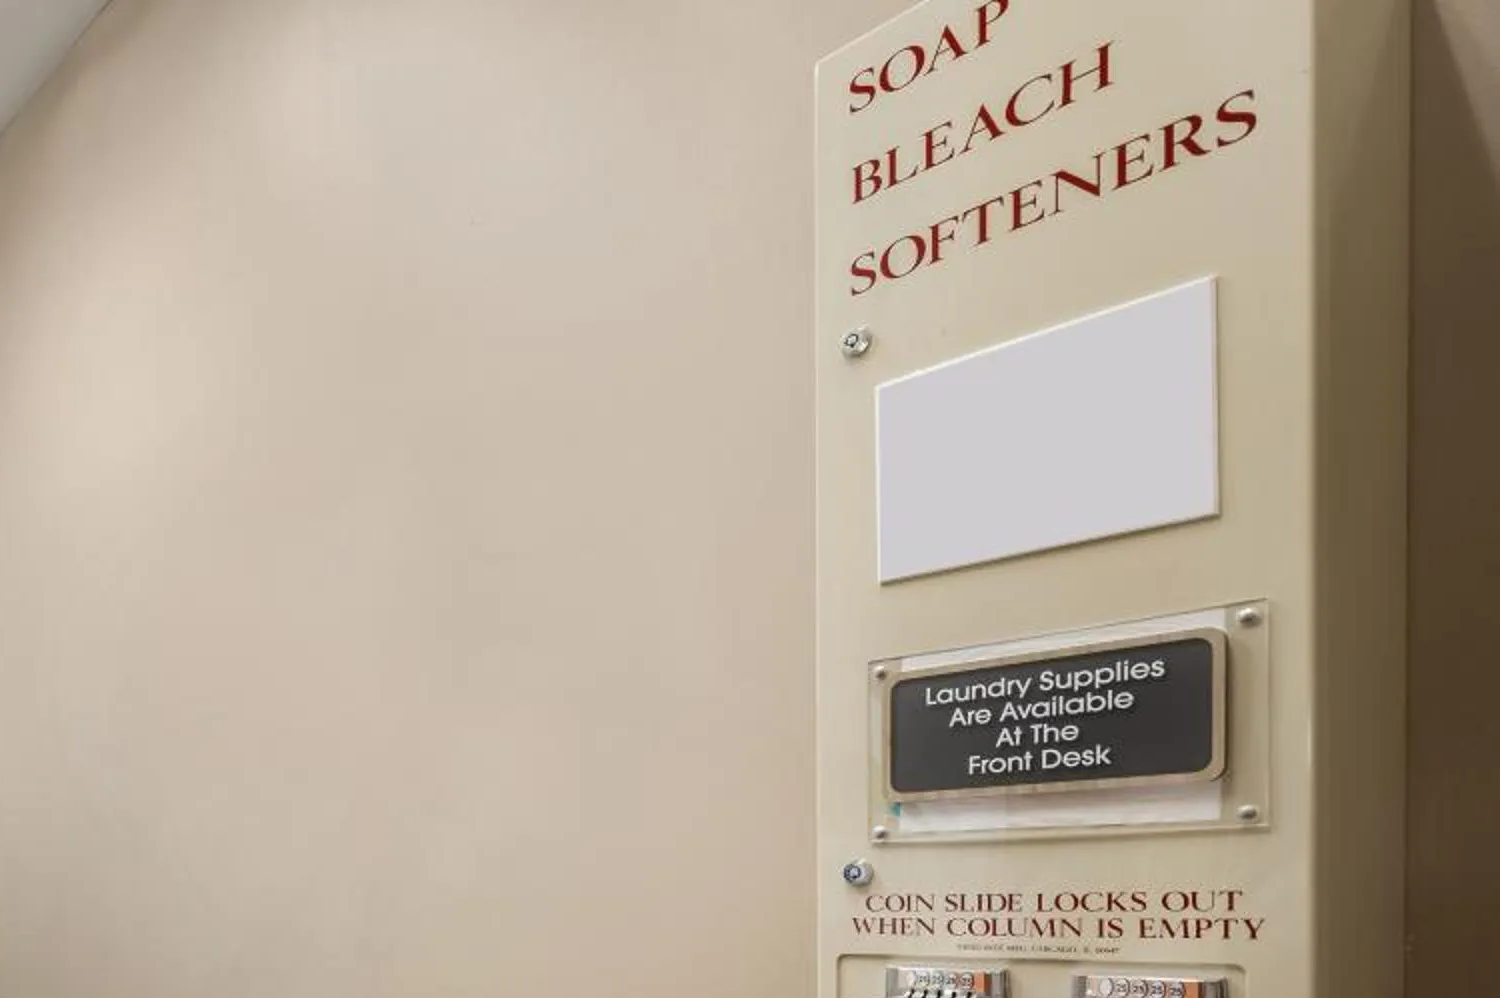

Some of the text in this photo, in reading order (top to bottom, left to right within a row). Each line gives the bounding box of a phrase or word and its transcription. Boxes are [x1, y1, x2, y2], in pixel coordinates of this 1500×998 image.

[849, 0, 1010, 113] SOAP
[852, 40, 1116, 204] BLEACH
[850, 89, 1257, 297] SOFTENERS
[925, 659, 1165, 705] Laundry Supplies
[949, 690, 1134, 727] Are Available
[996, 723, 1079, 748] At The
[968, 744, 1112, 775] Front Desk
[865, 890, 1243, 913] COIN SLIDE LOCKS OUT
[852, 917, 1265, 940] WHEN COLUMN IS EMPTY
